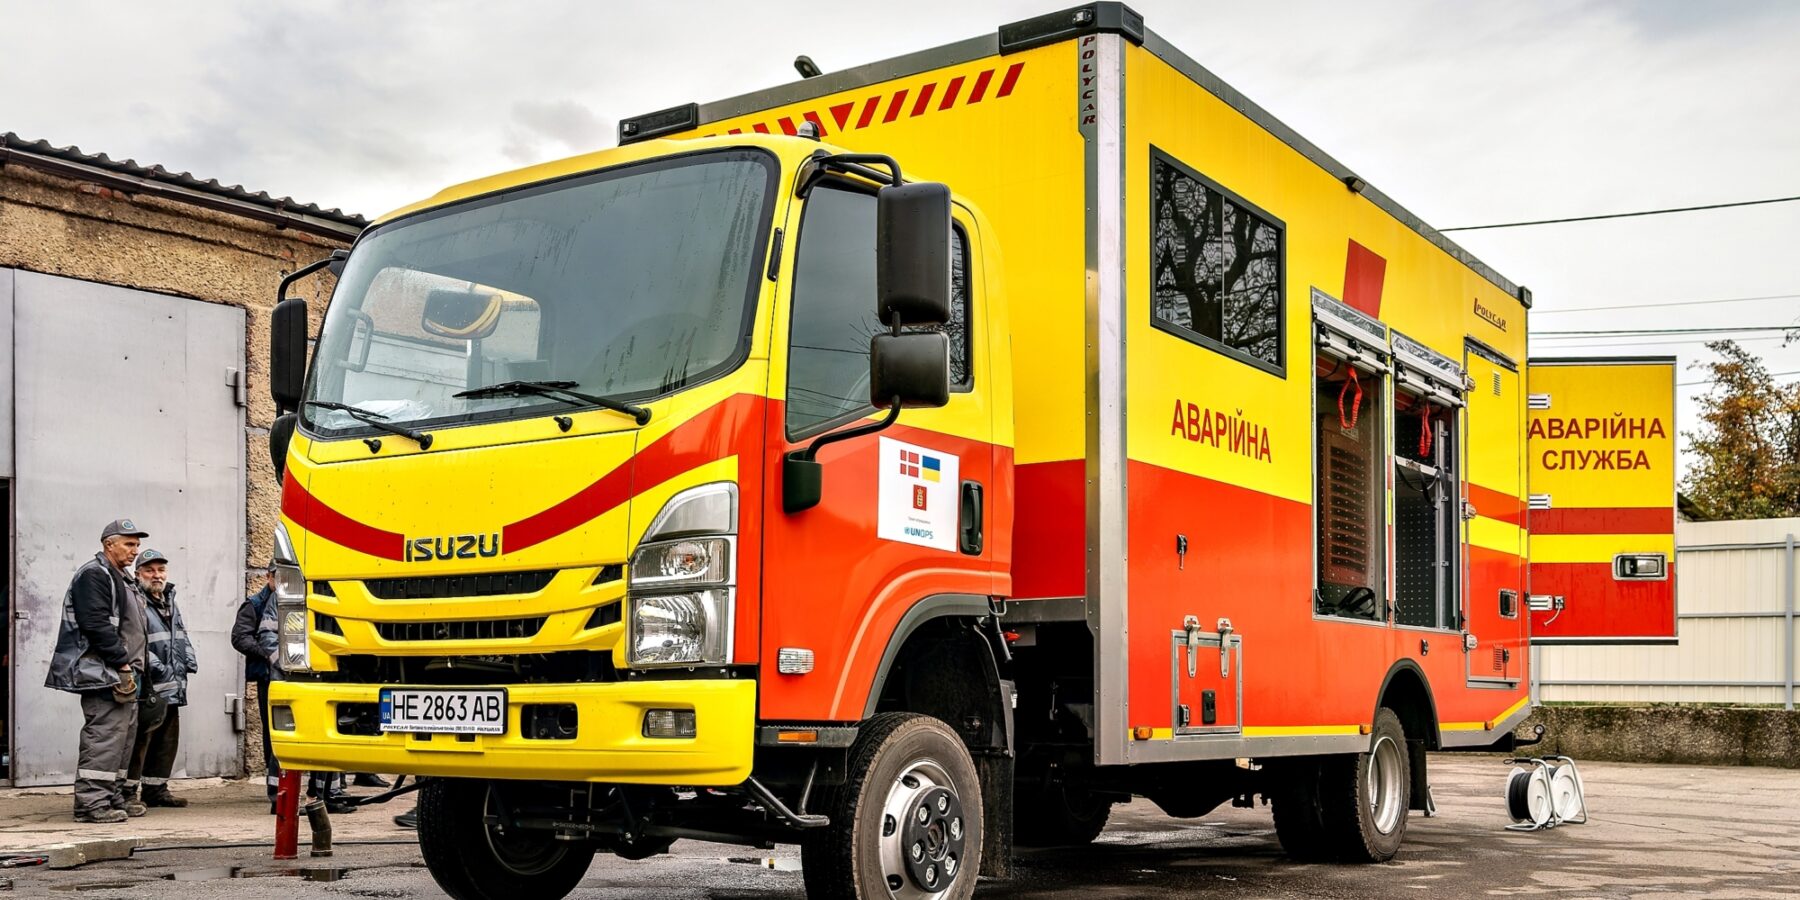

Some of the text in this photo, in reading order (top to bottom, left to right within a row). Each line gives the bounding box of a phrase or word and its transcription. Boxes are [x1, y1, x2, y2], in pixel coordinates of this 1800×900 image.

[1082, 36, 1096, 125] POLYCAR
[1476, 303, 1507, 329] POLYCAR
[1171, 398, 1272, 464] АВАРІЙНА
[1527, 411, 1666, 439] АВАРІЙНА
[1542, 449, 1651, 470] СЛУЖБА
[405, 532, 499, 562] ISUZU
[911, 528, 934, 540] UNOPS
[382, 711, 391, 720] UA
[392, 694, 500, 721] HE 2863 AB
